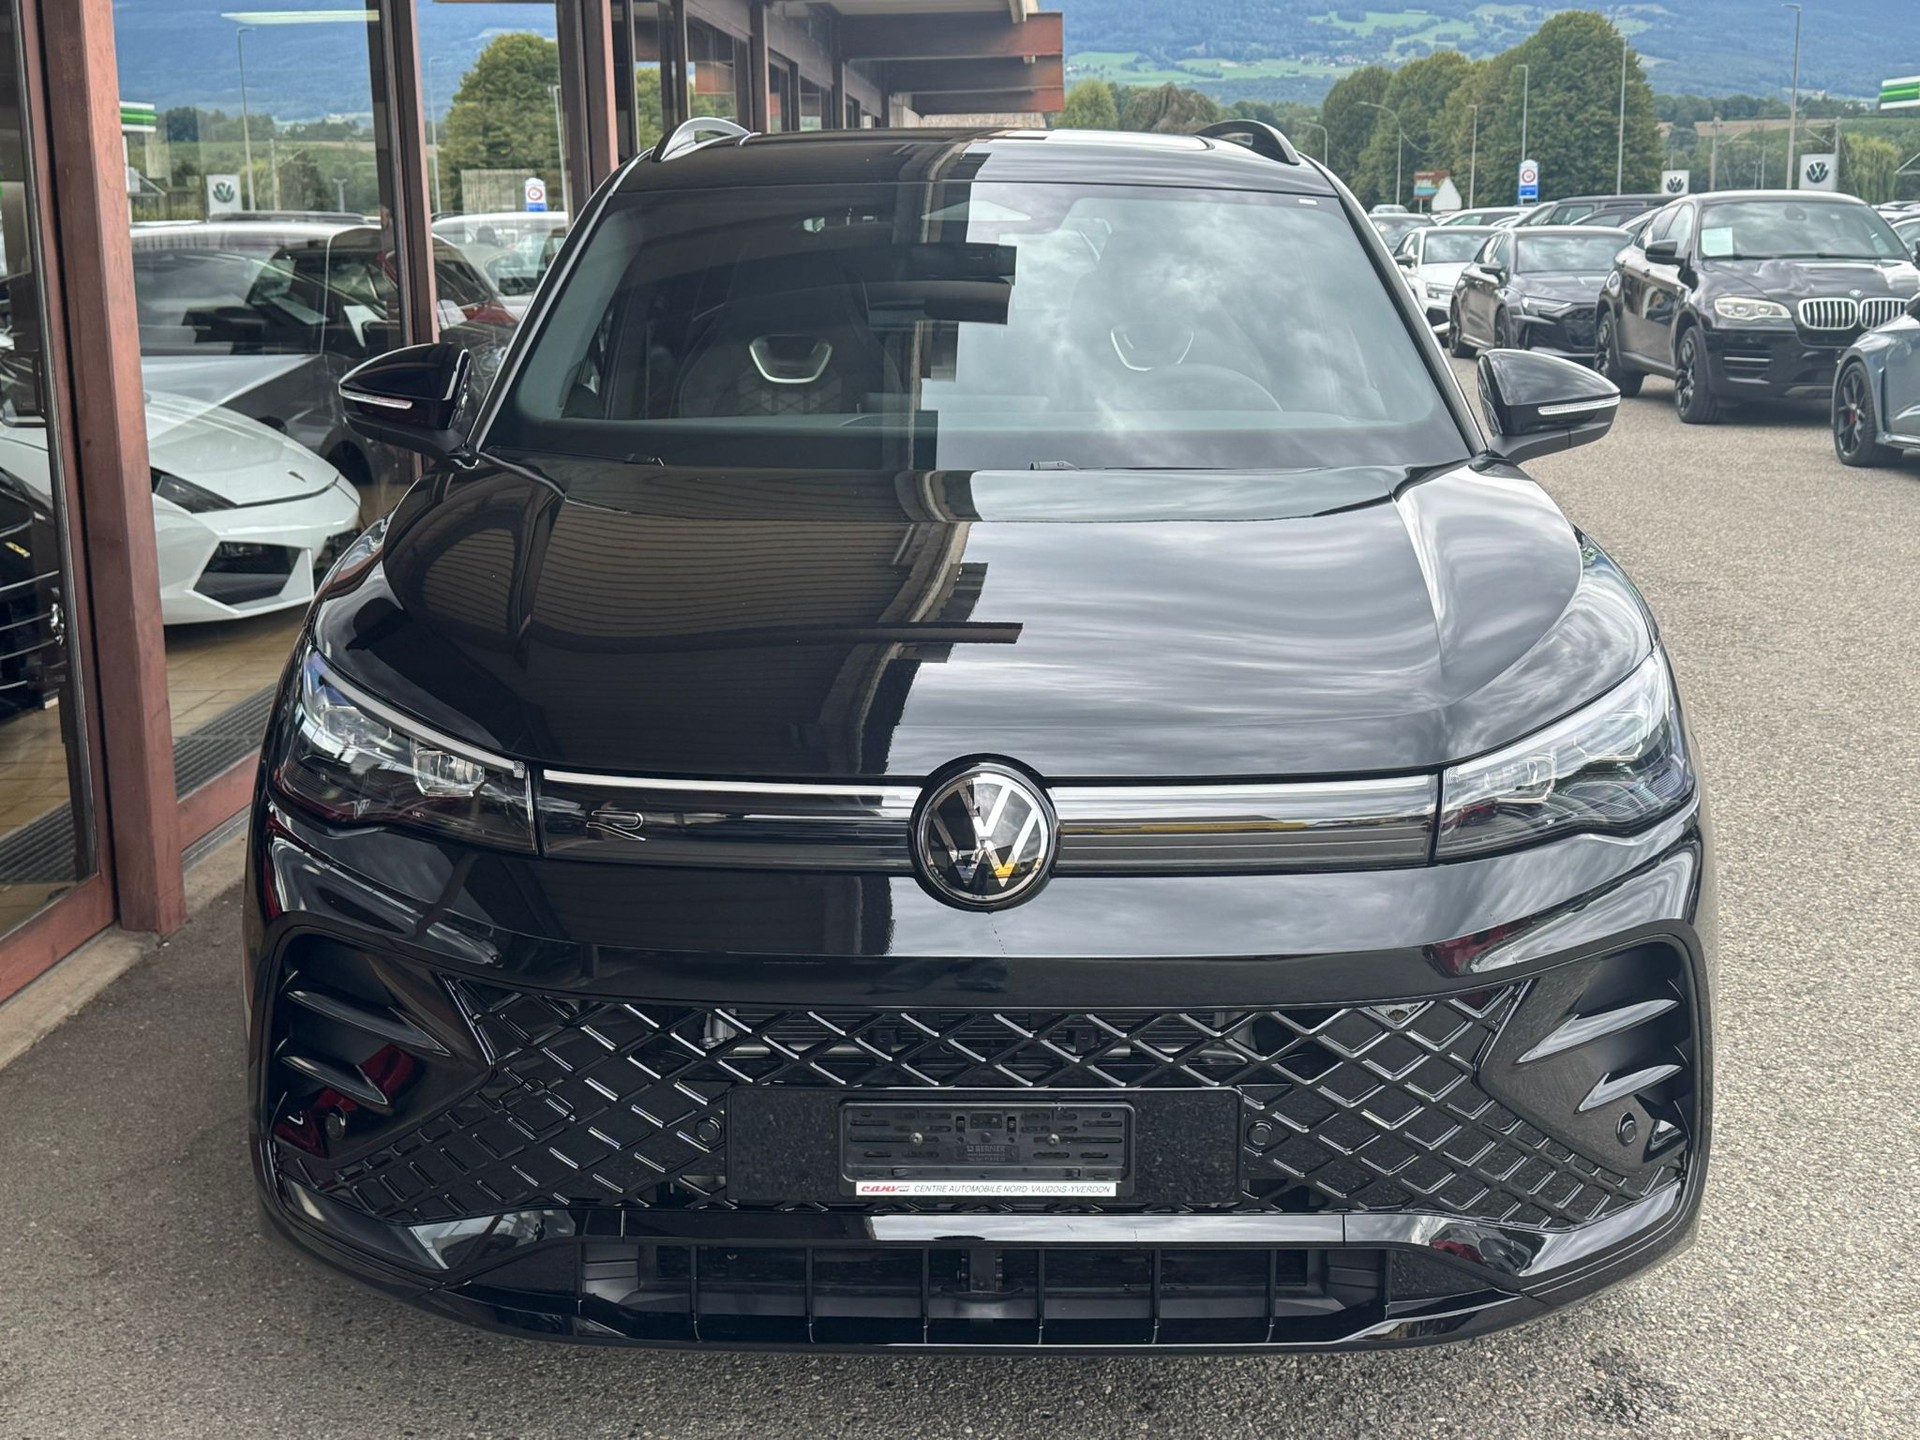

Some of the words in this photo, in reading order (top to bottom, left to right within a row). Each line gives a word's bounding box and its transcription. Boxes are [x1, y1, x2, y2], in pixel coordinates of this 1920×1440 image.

[919, 770, 1050, 902] VW
[914, 1184, 949, 1193] CENTRE
[949, 1184, 1003, 1193] AUTOMOBILE
[1003, 1184, 1029, 1193] NORD
[1031, 1184, 1067, 1193] VAUDOIS
